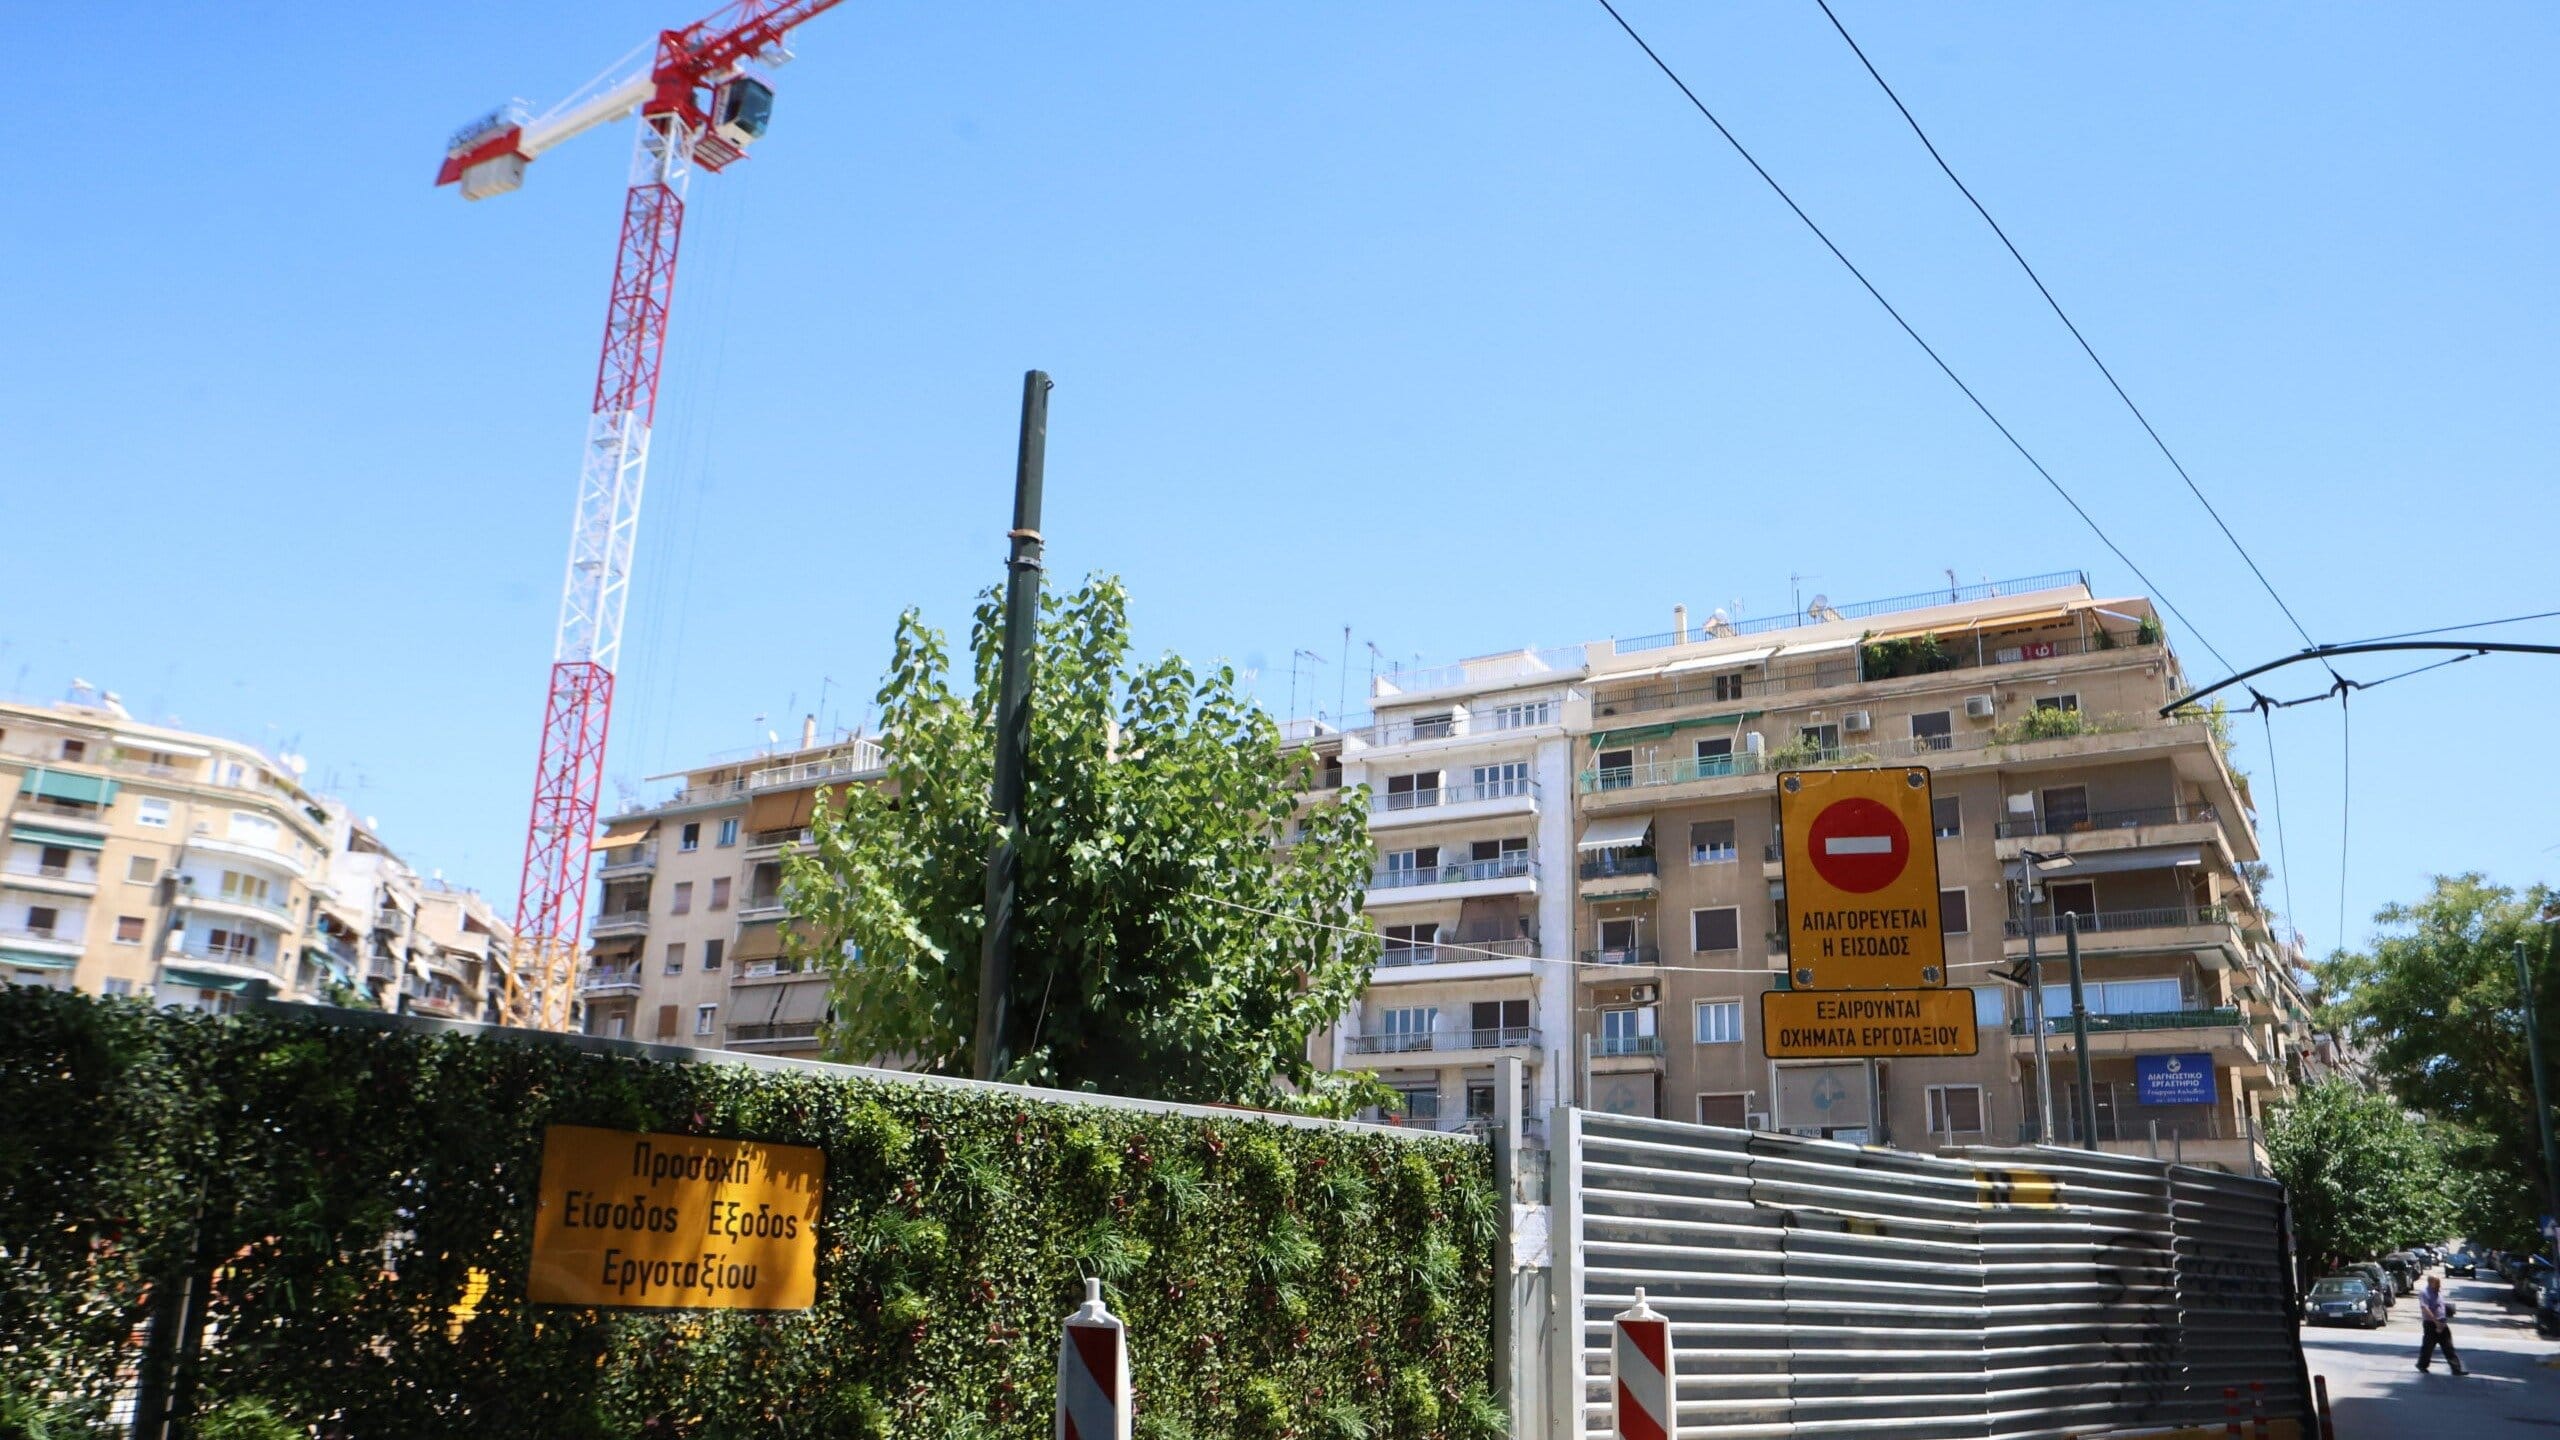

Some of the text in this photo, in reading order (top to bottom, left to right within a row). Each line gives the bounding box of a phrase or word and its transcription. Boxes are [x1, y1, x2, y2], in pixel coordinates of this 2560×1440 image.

[1802, 909, 1928, 932] ΑΠΑΓΟΡΕΥΕΤΑΙ
[1823, 936, 1910, 957] Η ΕΙΣΟΔΟΣ
[1817, 1000, 1921, 1020] ΕΞΑΙΡΟΥΝΤΑΙ
[1780, 1026, 1959, 1048] ΟΧΗΜΑΤΑ ΕΡΓΟΤΑΞΙΟΥ
[632, 1141, 750, 1187] Προσοχή
[563, 1190, 798, 1243] Είσοδος Εξοδος
[601, 1249, 758, 1296] Εργοταξίου
